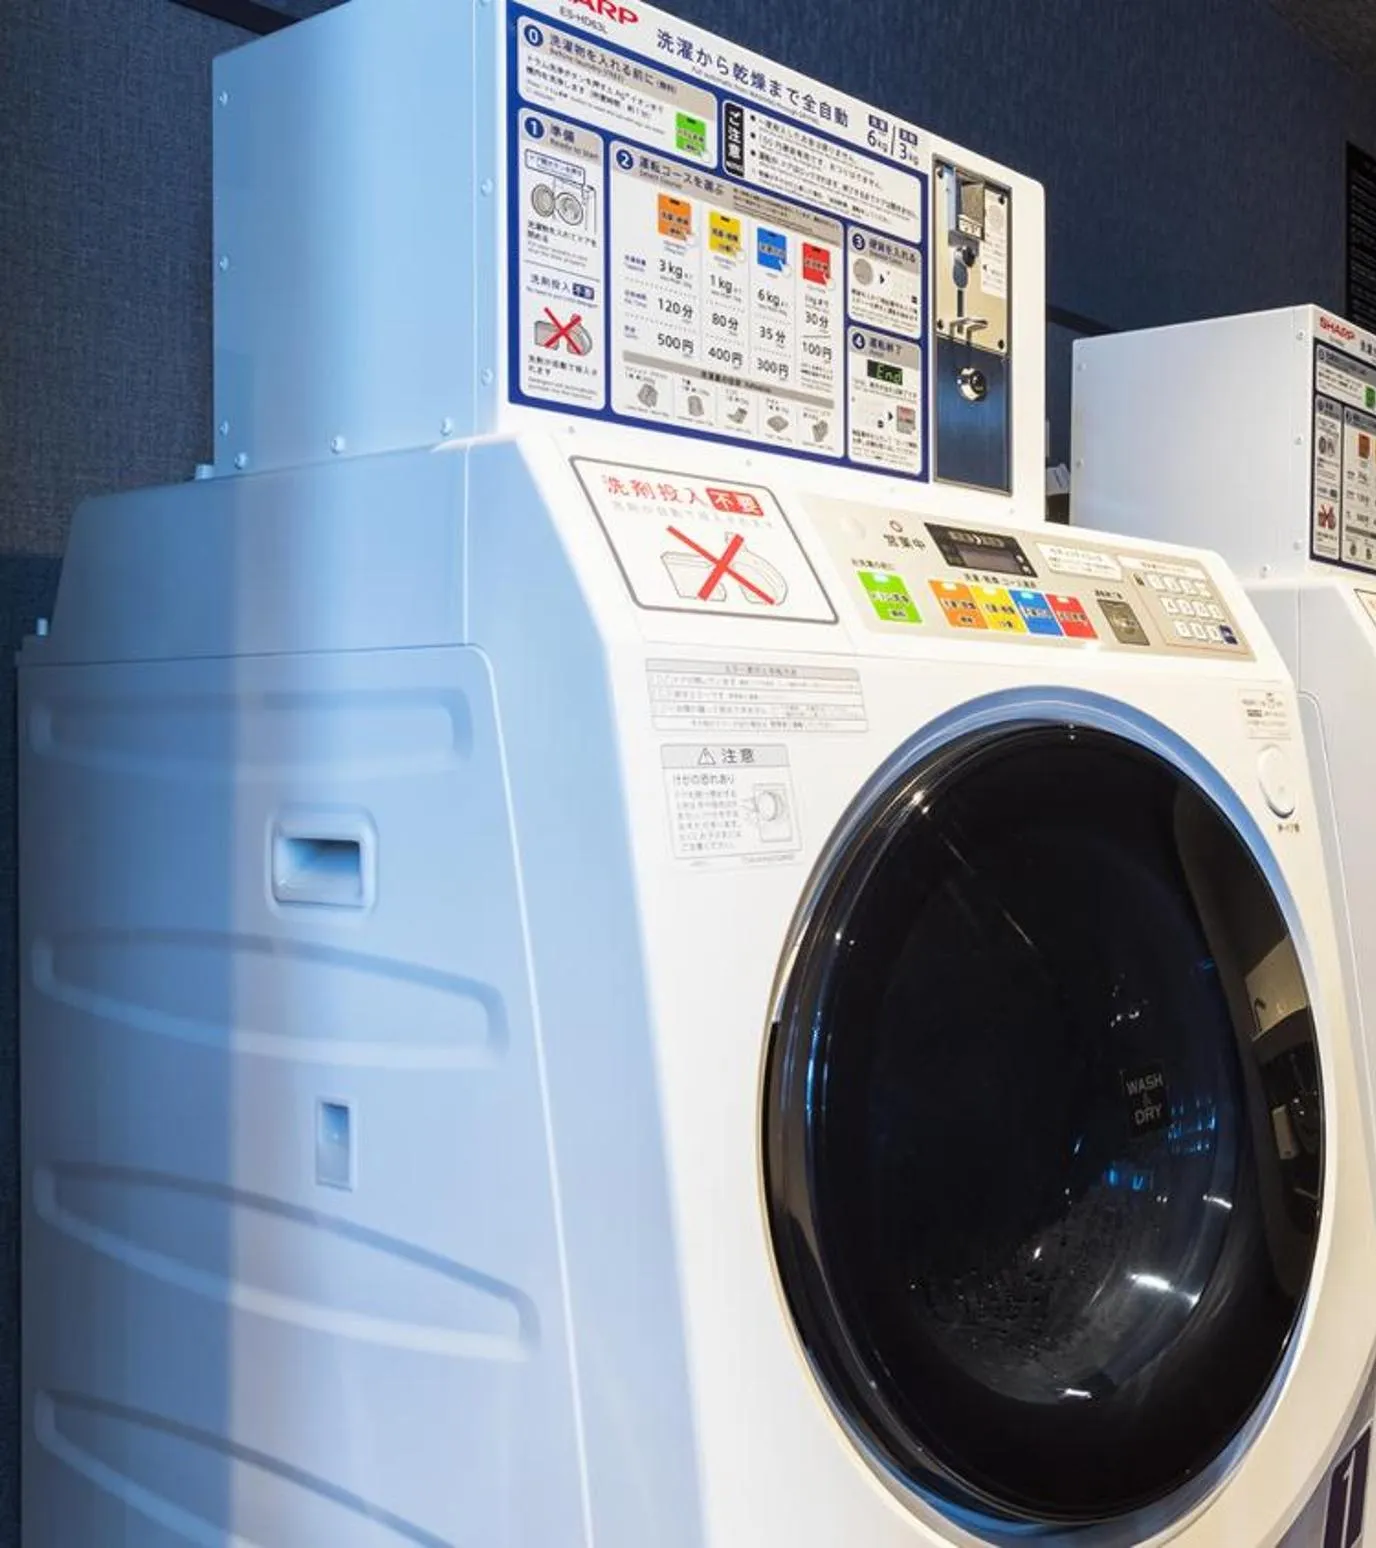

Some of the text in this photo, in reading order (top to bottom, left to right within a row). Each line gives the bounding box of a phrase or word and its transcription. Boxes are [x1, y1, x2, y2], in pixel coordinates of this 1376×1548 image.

[656, 28, 849, 128] 洗濯から乾燥まで全自動
[529, 121, 539, 137] 1
[728, 111, 741, 160] ご注意
[620, 152, 630, 167] 2
[658, 298, 693, 320] 120分
[711, 313, 739, 332] 80分
[1319, 316, 1356, 340] SHARP
[657, 333, 694, 355] 500円
[708, 346, 743, 367] 400円
[756, 358, 789, 379] 300円
[605, 475, 708, 507] 洗剤投入
[721, 747, 755, 764] 注意
[1126, 1072, 1164, 1096] WASH
[1134, 1101, 1163, 1126] DRY
